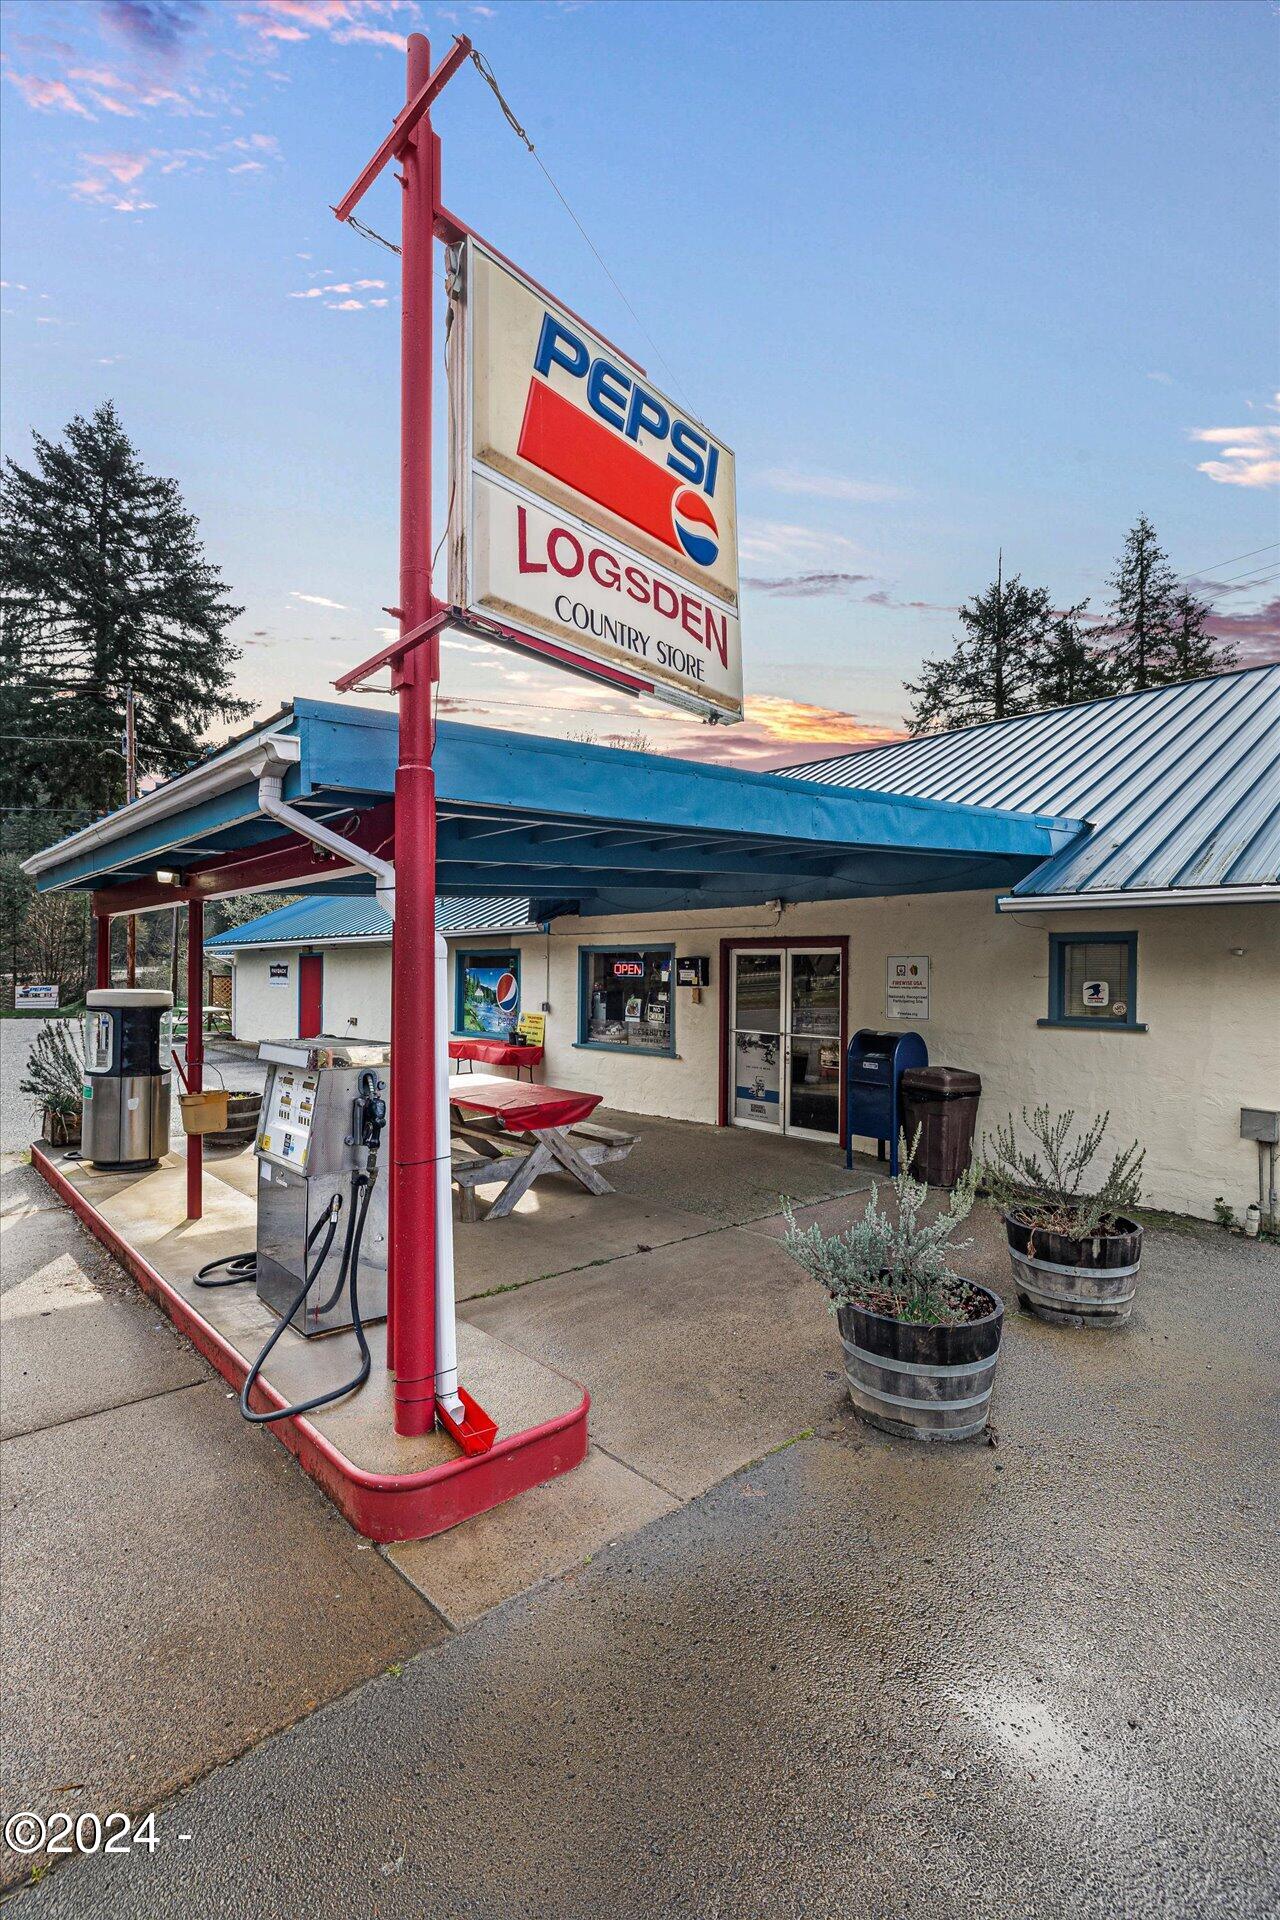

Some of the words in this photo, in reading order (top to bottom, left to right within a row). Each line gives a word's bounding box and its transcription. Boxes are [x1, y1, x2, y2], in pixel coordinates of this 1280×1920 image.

[533, 311, 720, 498] PEPSI
[517, 504, 728, 670] LOGSDEN
[555, 595, 651, 656] COUNTRY
[656, 640, 705, 683] STORE
[613, 963, 642, 975] OPEN
